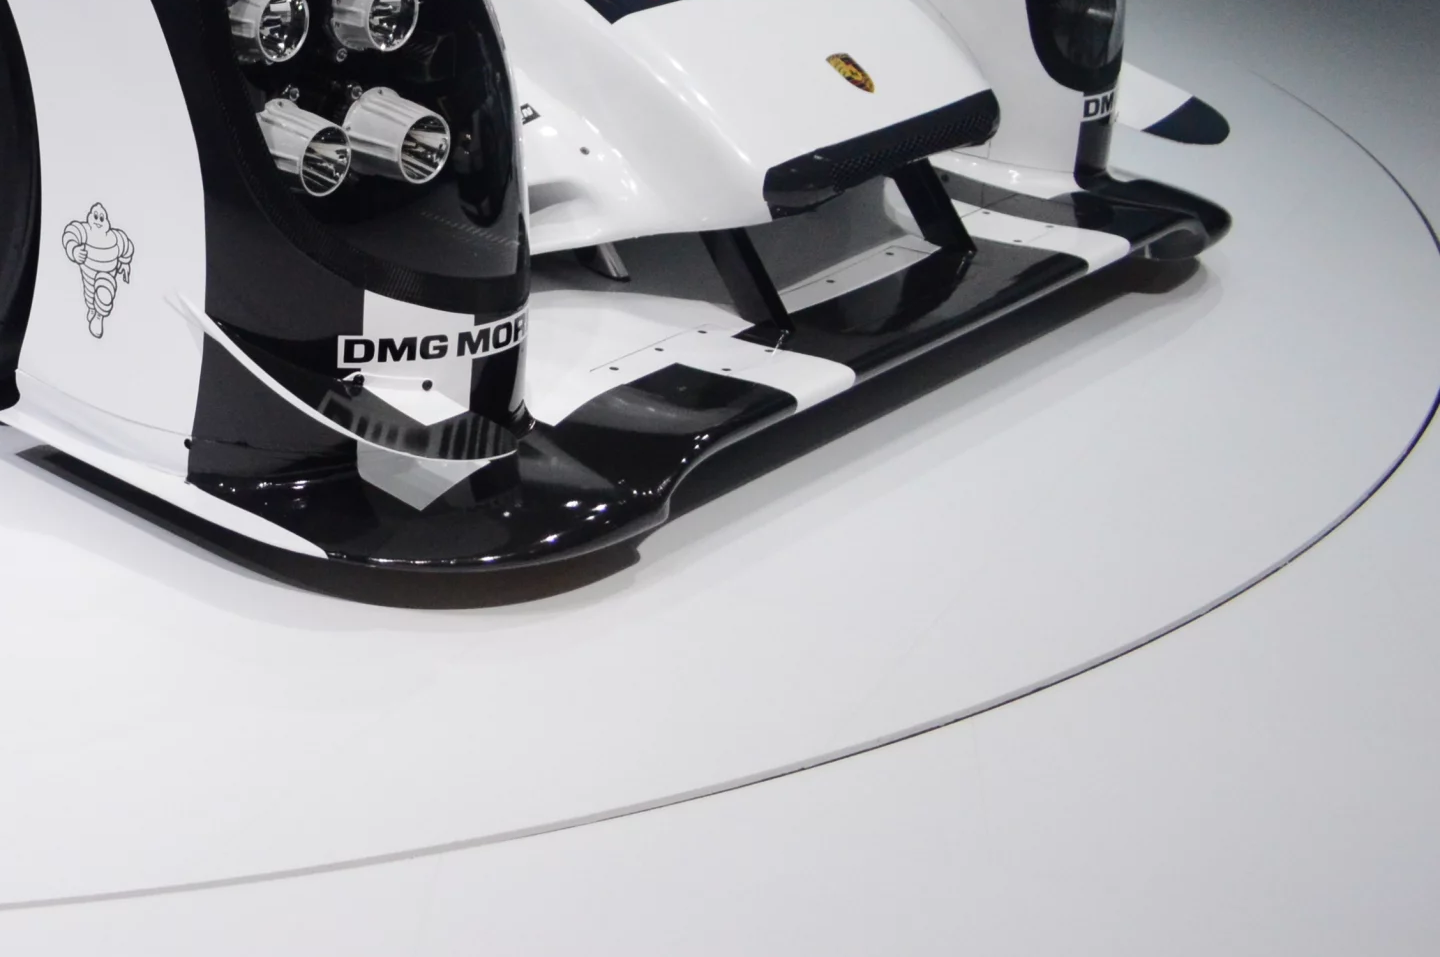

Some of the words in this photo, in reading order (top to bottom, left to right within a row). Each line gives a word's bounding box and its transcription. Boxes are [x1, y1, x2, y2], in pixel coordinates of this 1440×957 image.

[1083, 91, 1115, 119] DM
[343, 334, 449, 364] DMG
[456, 312, 527, 358] MOR
